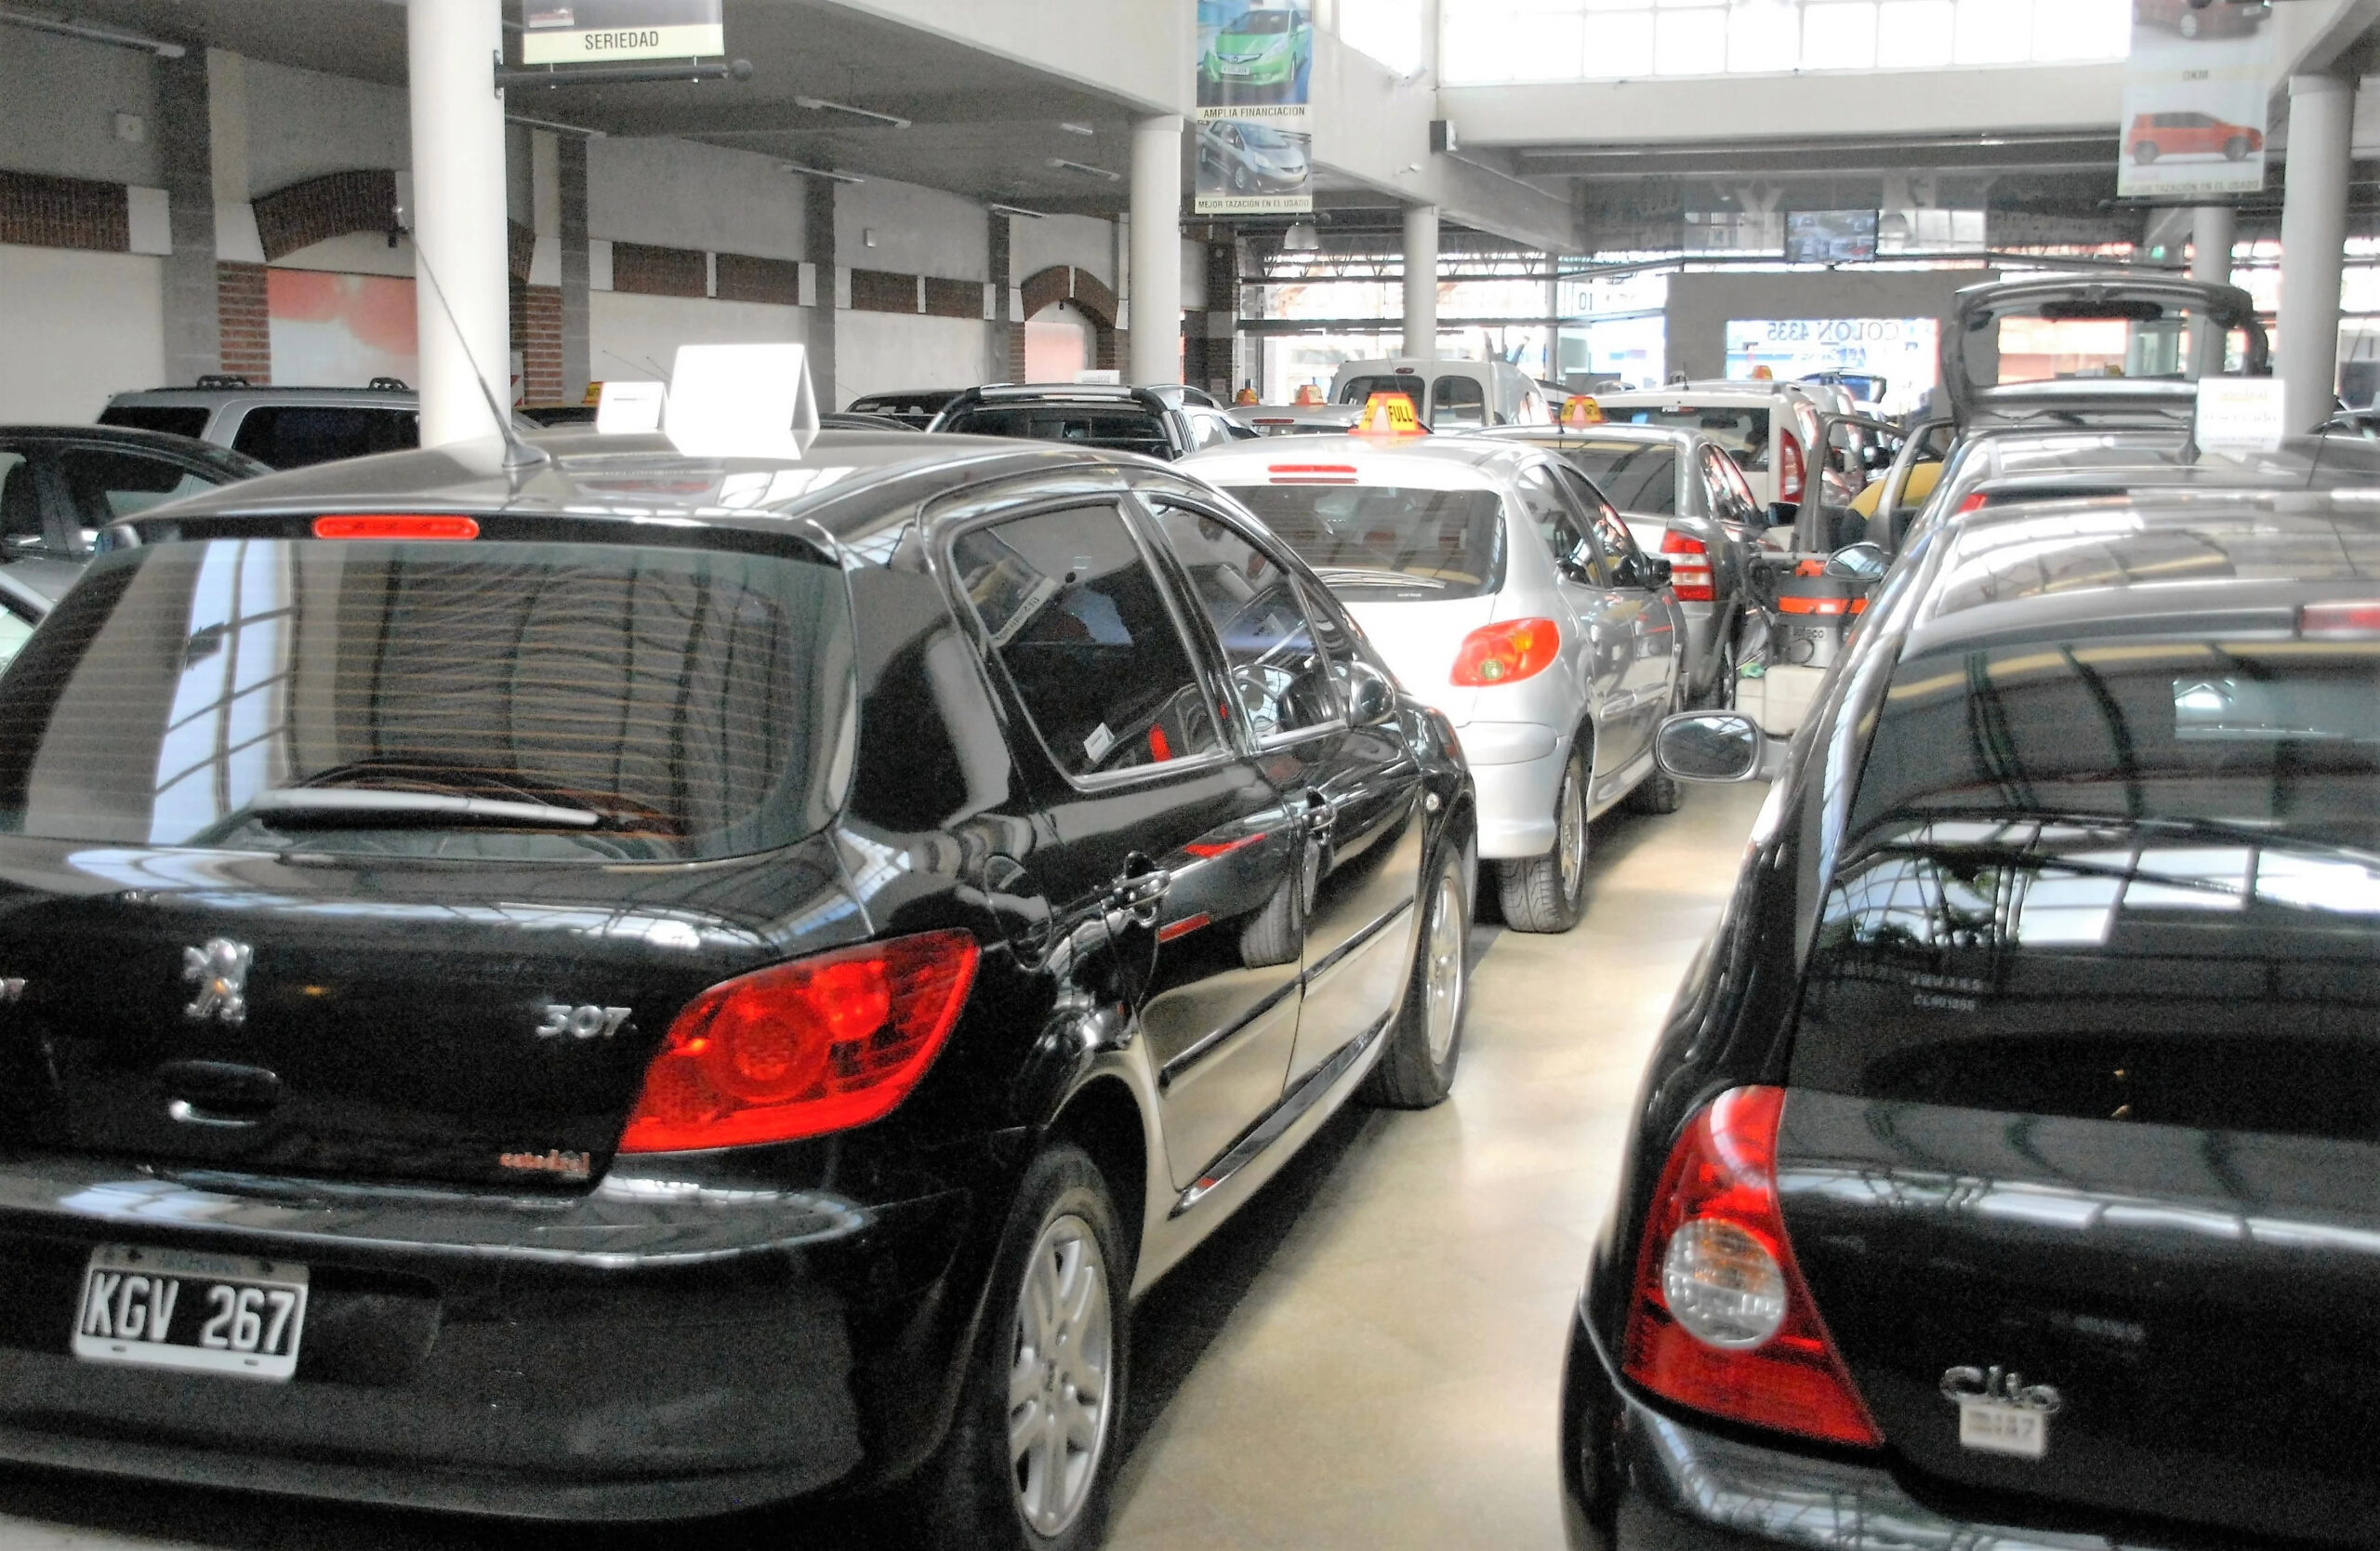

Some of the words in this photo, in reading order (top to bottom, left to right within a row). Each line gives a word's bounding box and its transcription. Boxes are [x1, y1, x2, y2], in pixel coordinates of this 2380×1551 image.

[585, 31, 659, 50] SERIEDAD
[1203, 108, 1238, 118] AMPLIA
[1240, 106, 1305, 117] FINANCIACION
[1198, 200, 1223, 209] MEJOR
[1262, 200, 1272, 208] EN
[1273, 199, 1281, 207] EL
[1284, 198, 1309, 208] USADO
[1388, 405, 1413, 423] FULL
[536, 1004, 633, 1040] 307
[84, 1271, 179, 1343] KGV
[201, 1284, 297, 1355] 267
